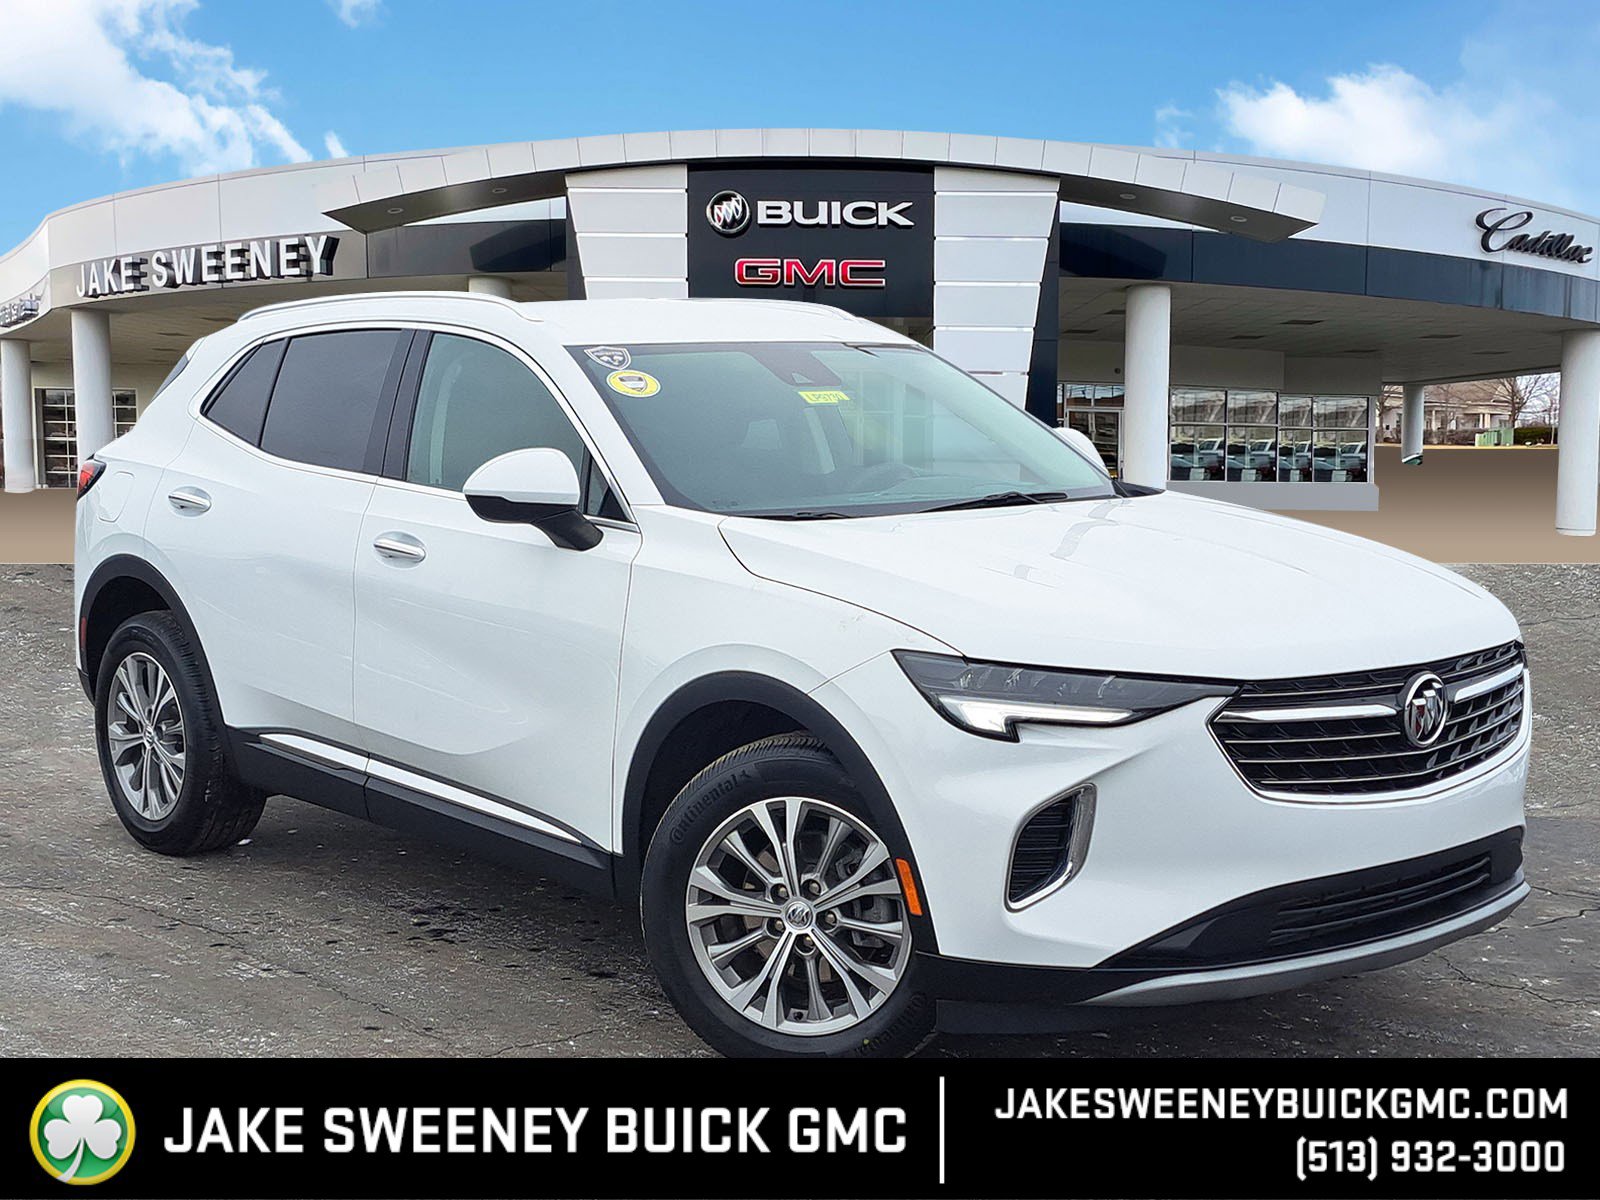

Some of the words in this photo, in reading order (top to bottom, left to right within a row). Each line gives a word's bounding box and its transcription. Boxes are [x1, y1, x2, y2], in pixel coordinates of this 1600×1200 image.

[757, 200, 914, 226] BUICK
[1475, 207, 1593, 263] Cadillac
[76, 255, 140, 298] JAKE
[151, 235, 332, 288] SWEENEY
[735, 258, 886, 287] GMC
[669, 773, 739, 845] Continental
